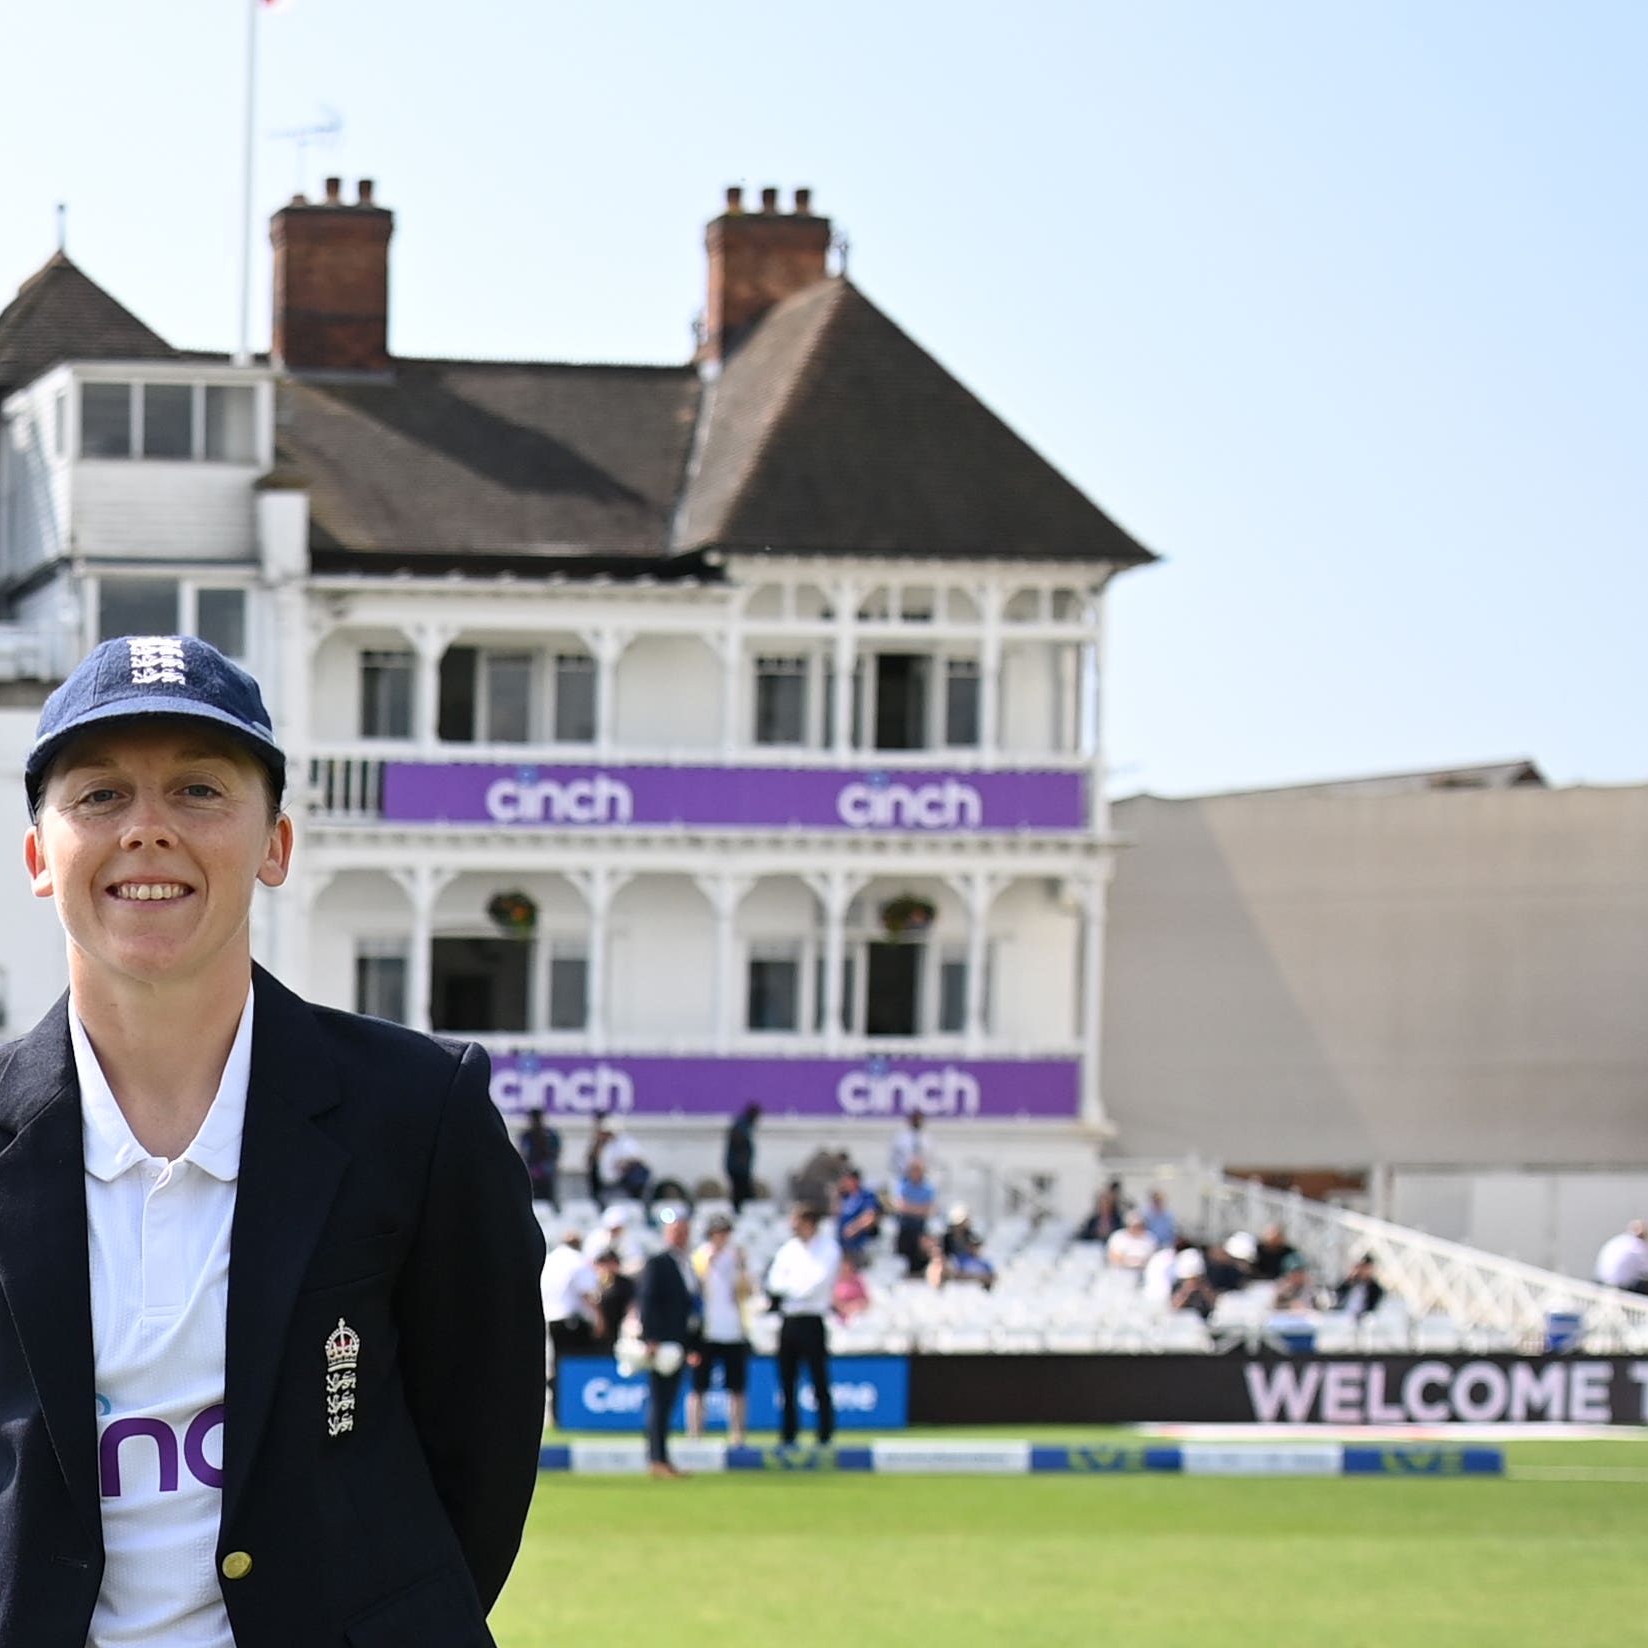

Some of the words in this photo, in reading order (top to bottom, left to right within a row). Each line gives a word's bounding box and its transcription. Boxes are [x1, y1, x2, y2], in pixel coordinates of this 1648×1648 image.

[485, 766, 634, 824] cinch
[835, 772, 983, 828] cinch
[489, 1053, 634, 1113] cinch
[837, 1055, 981, 1116] cinch
[1244, 1361, 1614, 1423] WELCOME
